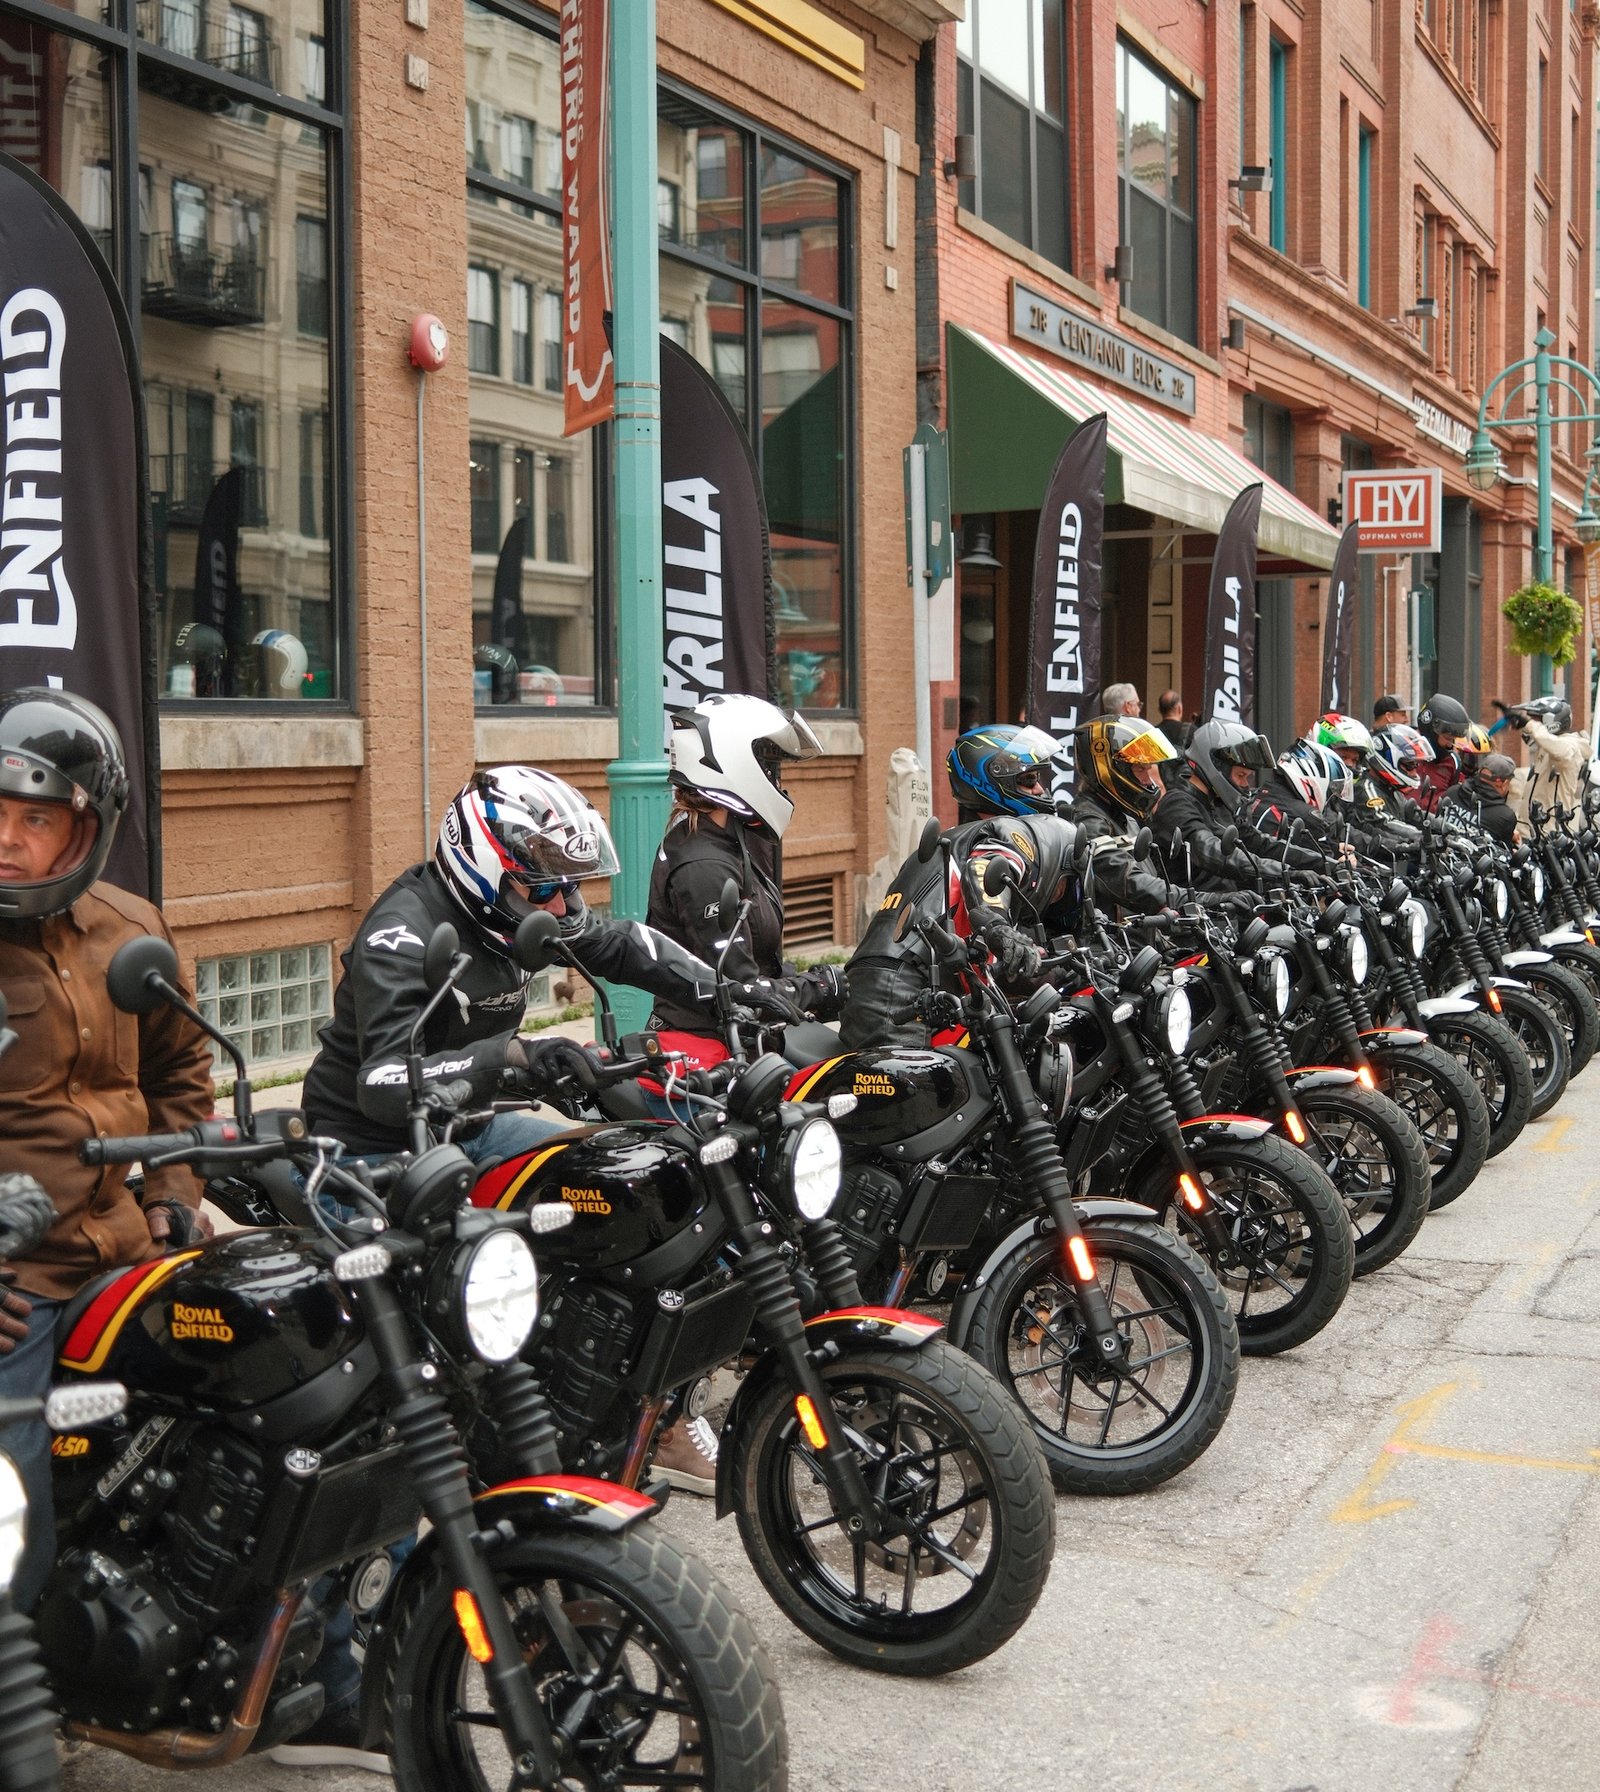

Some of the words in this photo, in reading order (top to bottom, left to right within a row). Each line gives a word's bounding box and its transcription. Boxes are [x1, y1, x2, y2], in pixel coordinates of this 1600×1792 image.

[562, 0, 579, 161] THIRD
[568, 168, 581, 334] WARD
[1030, 304, 1048, 333] 218
[1059, 316, 1126, 374] CENTANNI
[1132, 352, 1165, 393] BLDG.
[1172, 376, 1185, 399] 218
[0, 288, 78, 651] ENFIELD
[1359, 532, 1398, 541] OFFMAN
[1400, 532, 1425, 540] YORK
[1046, 502, 1083, 694] ENFIELD
[6, 758, 25, 768] BELL
[961, 767, 999, 797] HJC
[446, 810, 460, 844] Arai
[855, 1073, 890, 1085] ROYAL
[852, 1084, 896, 1097] ENFIELD
[561, 1186, 605, 1201] ROYAL
[561, 1201, 612, 1215] NFIELD
[173, 1303, 225, 1324] ROYAL
[171, 1322, 234, 1343] ENFIELD
[52, 1434, 90, 1458] 450
